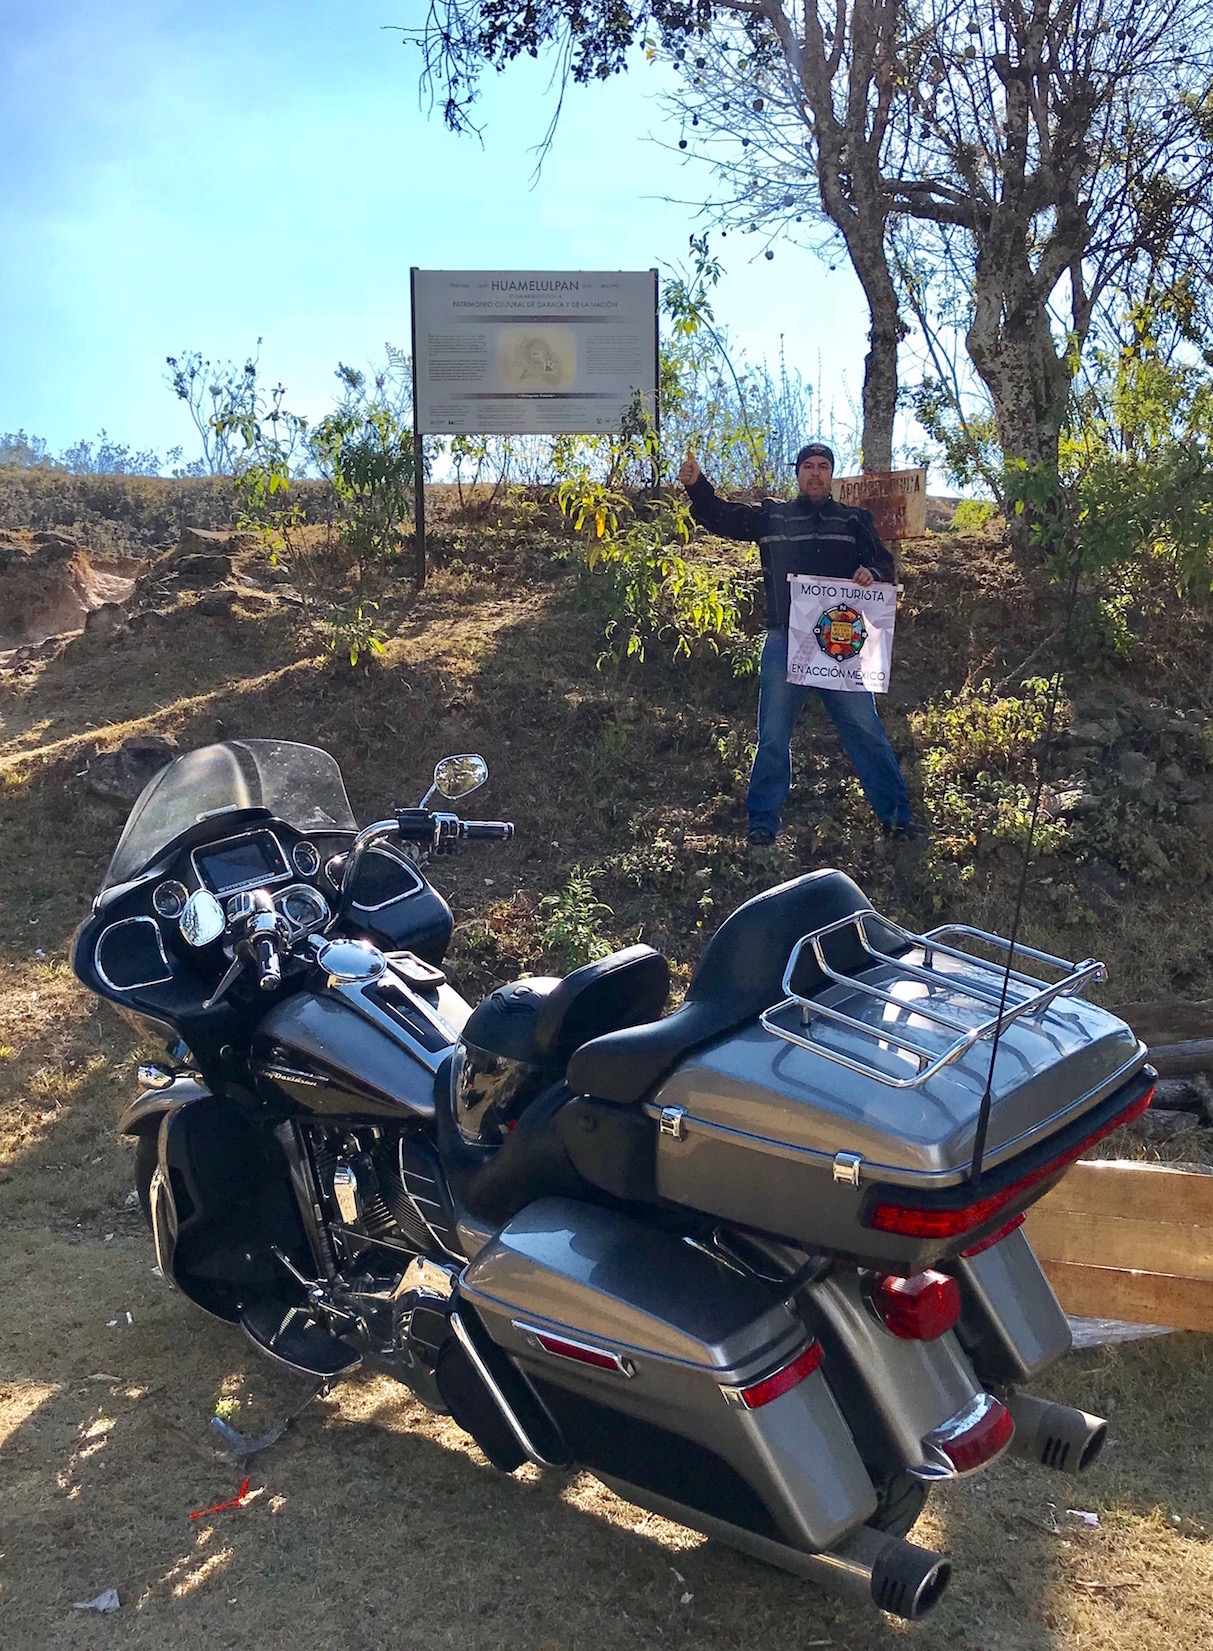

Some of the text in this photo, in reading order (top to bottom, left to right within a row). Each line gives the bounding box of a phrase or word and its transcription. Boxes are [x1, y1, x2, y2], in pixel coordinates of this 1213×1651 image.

[491, 280, 579, 291] HUAMELULPAN
[801, 583, 885, 602] MOTO TURISTA
[791, 663, 886, 681] EN ACCIÓN MÉXICO
